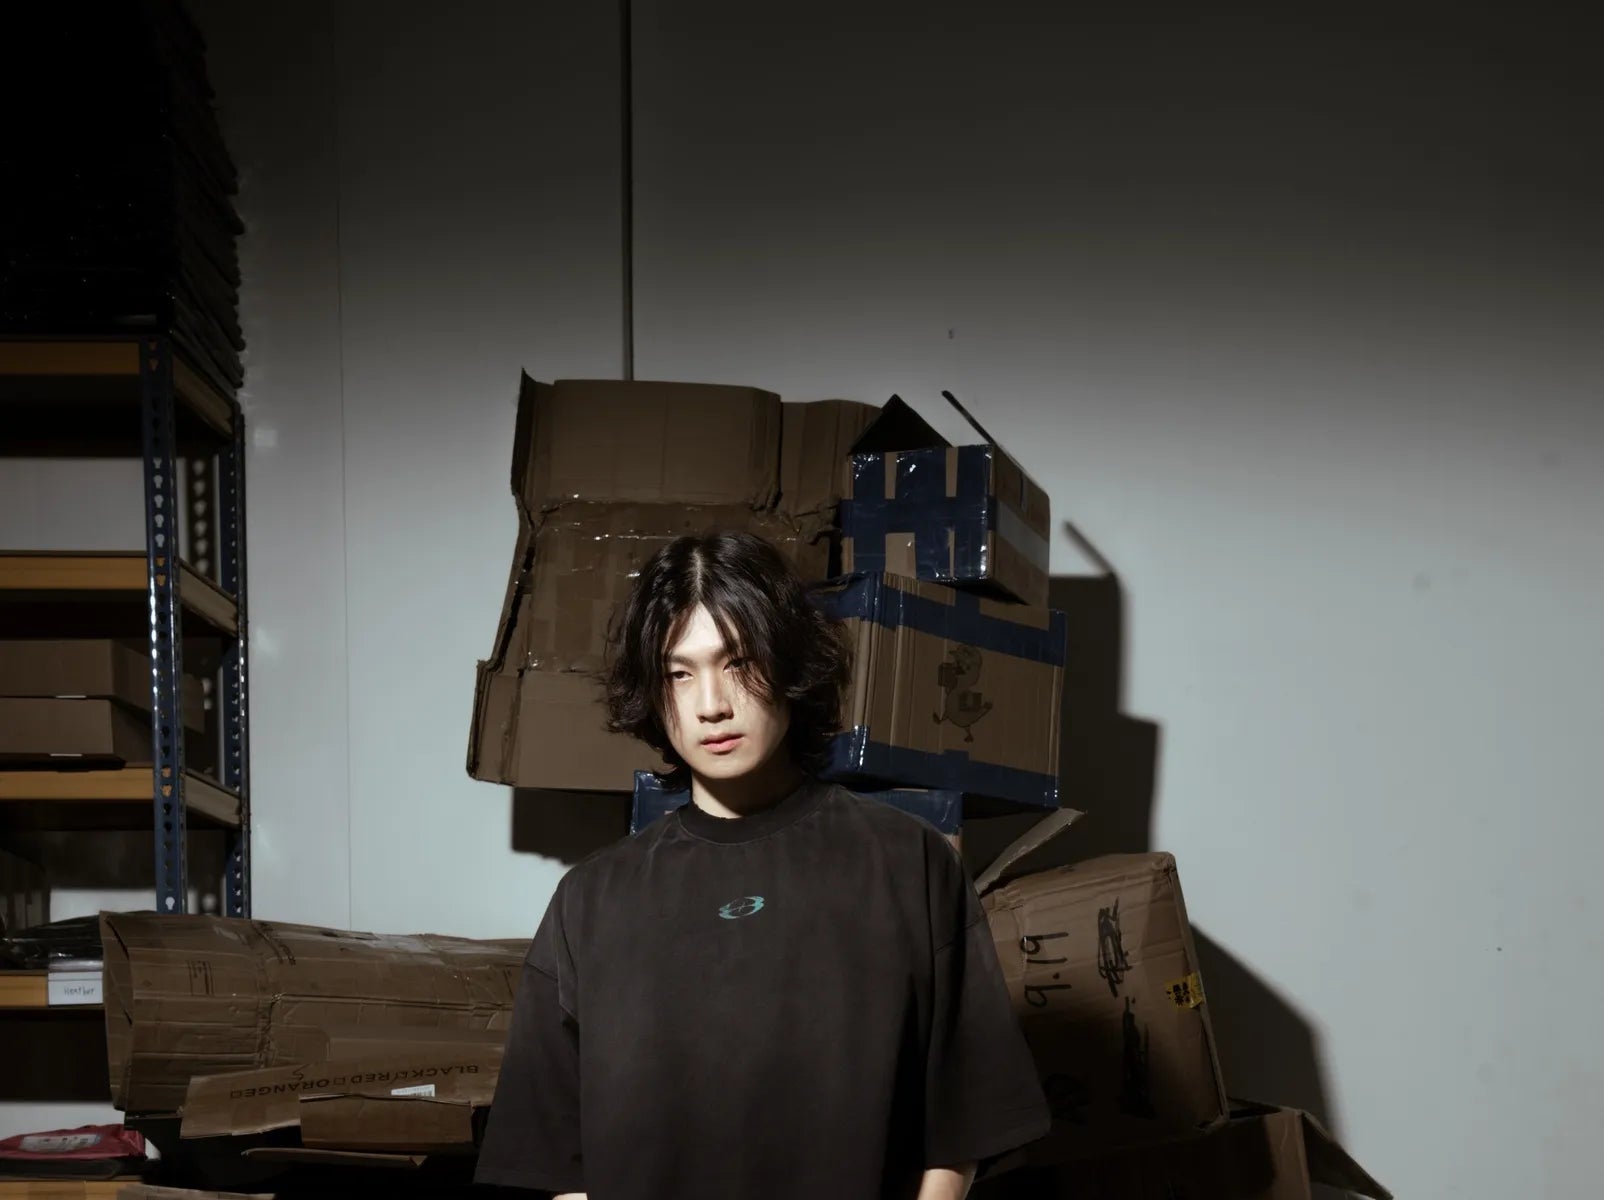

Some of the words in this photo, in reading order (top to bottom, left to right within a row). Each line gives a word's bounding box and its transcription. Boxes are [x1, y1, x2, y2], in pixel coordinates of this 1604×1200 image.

[1020, 931, 1072, 1008] 9.19
[350, 1071, 390, 1085] RED
[406, 1064, 478, 1078] BLACK
[244, 1078, 330, 1098] ORANGE
